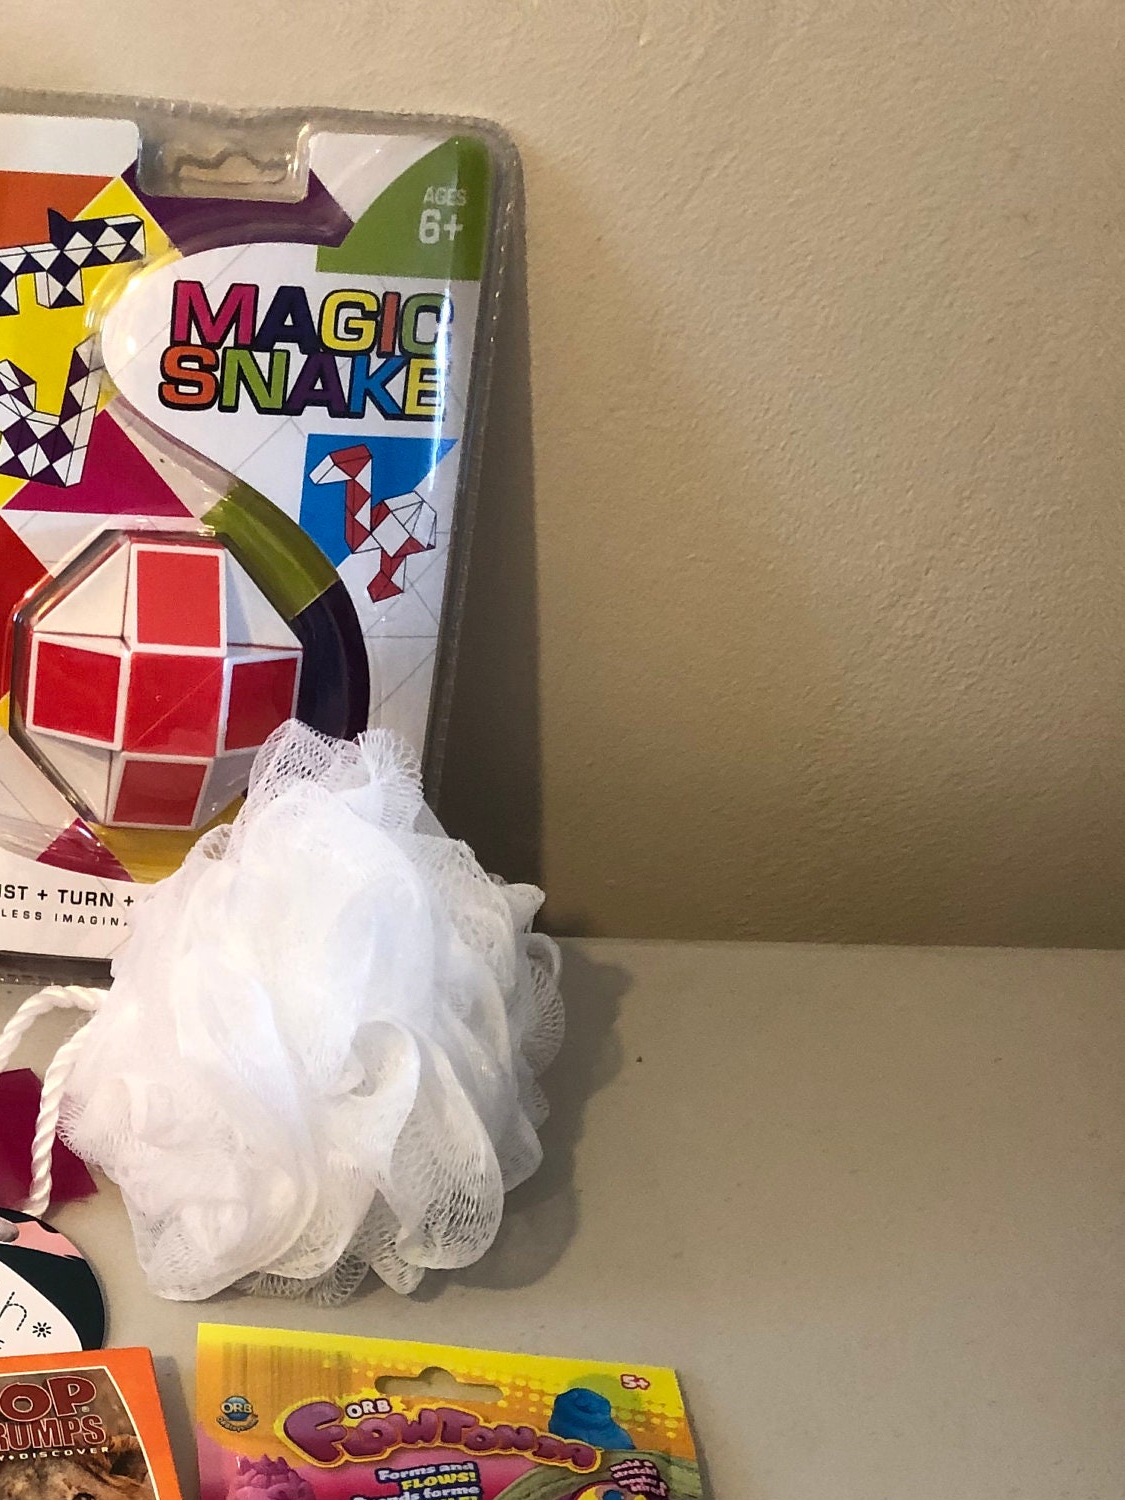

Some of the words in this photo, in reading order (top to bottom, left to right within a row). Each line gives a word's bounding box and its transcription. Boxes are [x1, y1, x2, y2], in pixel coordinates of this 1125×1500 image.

[423, 186, 467, 207] AGES
[419, 209, 464, 244] 6+
[173, 280, 455, 353] MAGIC
[159, 346, 453, 419] SNAKE
[57, 889, 114, 907] TURN
[55, 913, 128, 927] IMAGIN
[621, 1374, 650, 1390] 5+
[221, 1402, 253, 1414] ORB
[346, 1399, 392, 1419] ORB
[378, 1465, 436, 1482] Forms
[438, 1461, 475, 1474] and
[401, 1472, 478, 1491] FLOWS!
[423, 1485, 480, 1500] forme
